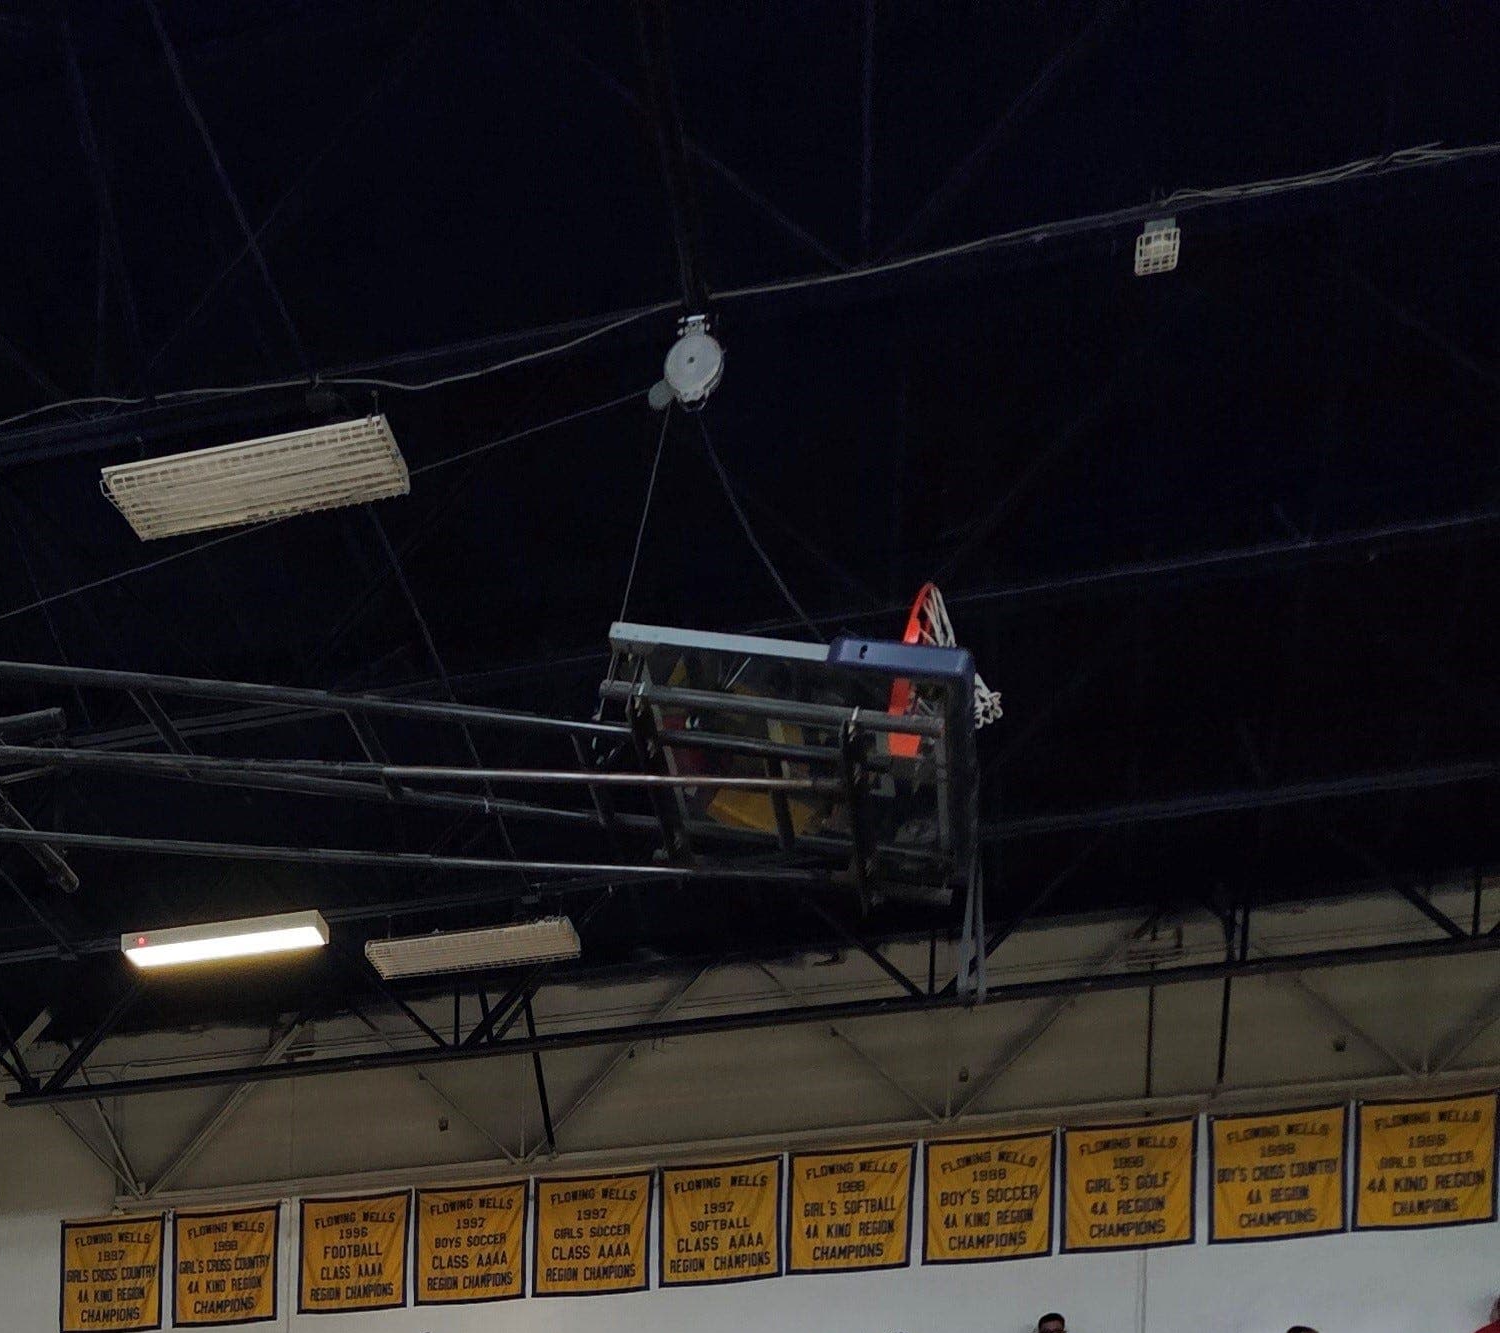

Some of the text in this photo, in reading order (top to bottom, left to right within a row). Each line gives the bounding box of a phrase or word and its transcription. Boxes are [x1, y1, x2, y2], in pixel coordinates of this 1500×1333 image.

[674, 1175, 768, 1194] FLOWING WELLS
[551, 1188, 637, 1205] FLOWING WELLS
[940, 1184, 1039, 1207] BOY'S SOCCER
[431, 1198, 513, 1216] FLOWING WELLS
[844, 1196, 895, 1215] SOFTBALL
[315, 1212, 395, 1229] FLOWING WELLS
[690, 1217, 750, 1233] SOFTBALL
[435, 1232, 506, 1249] BOYS SOCCER
[554, 1224, 630, 1239] GIRLS SOCCER
[677, 1231, 763, 1253] CLASS AAAA
[949, 1231, 1027, 1251] CHAMPIONS
[324, 1242, 382, 1259] FOOTBALL
[552, 1243, 630, 1260] CLASS AAAA
[812, 1243, 884, 1261] CHAMPIONS
[432, 1251, 507, 1270] CLASS AAAA
[670, 1251, 770, 1273] REGION CHAMPIONS
[321, 1262, 383, 1280] CLASS AAAA
[546, 1264, 635, 1282] REGION CHAMPIONS
[427, 1272, 512, 1291] REGION CHAMPIONS
[310, 1282, 394, 1302] REGION CHAMPIONS
[81, 1307, 140, 1323] CHAMPIONS
